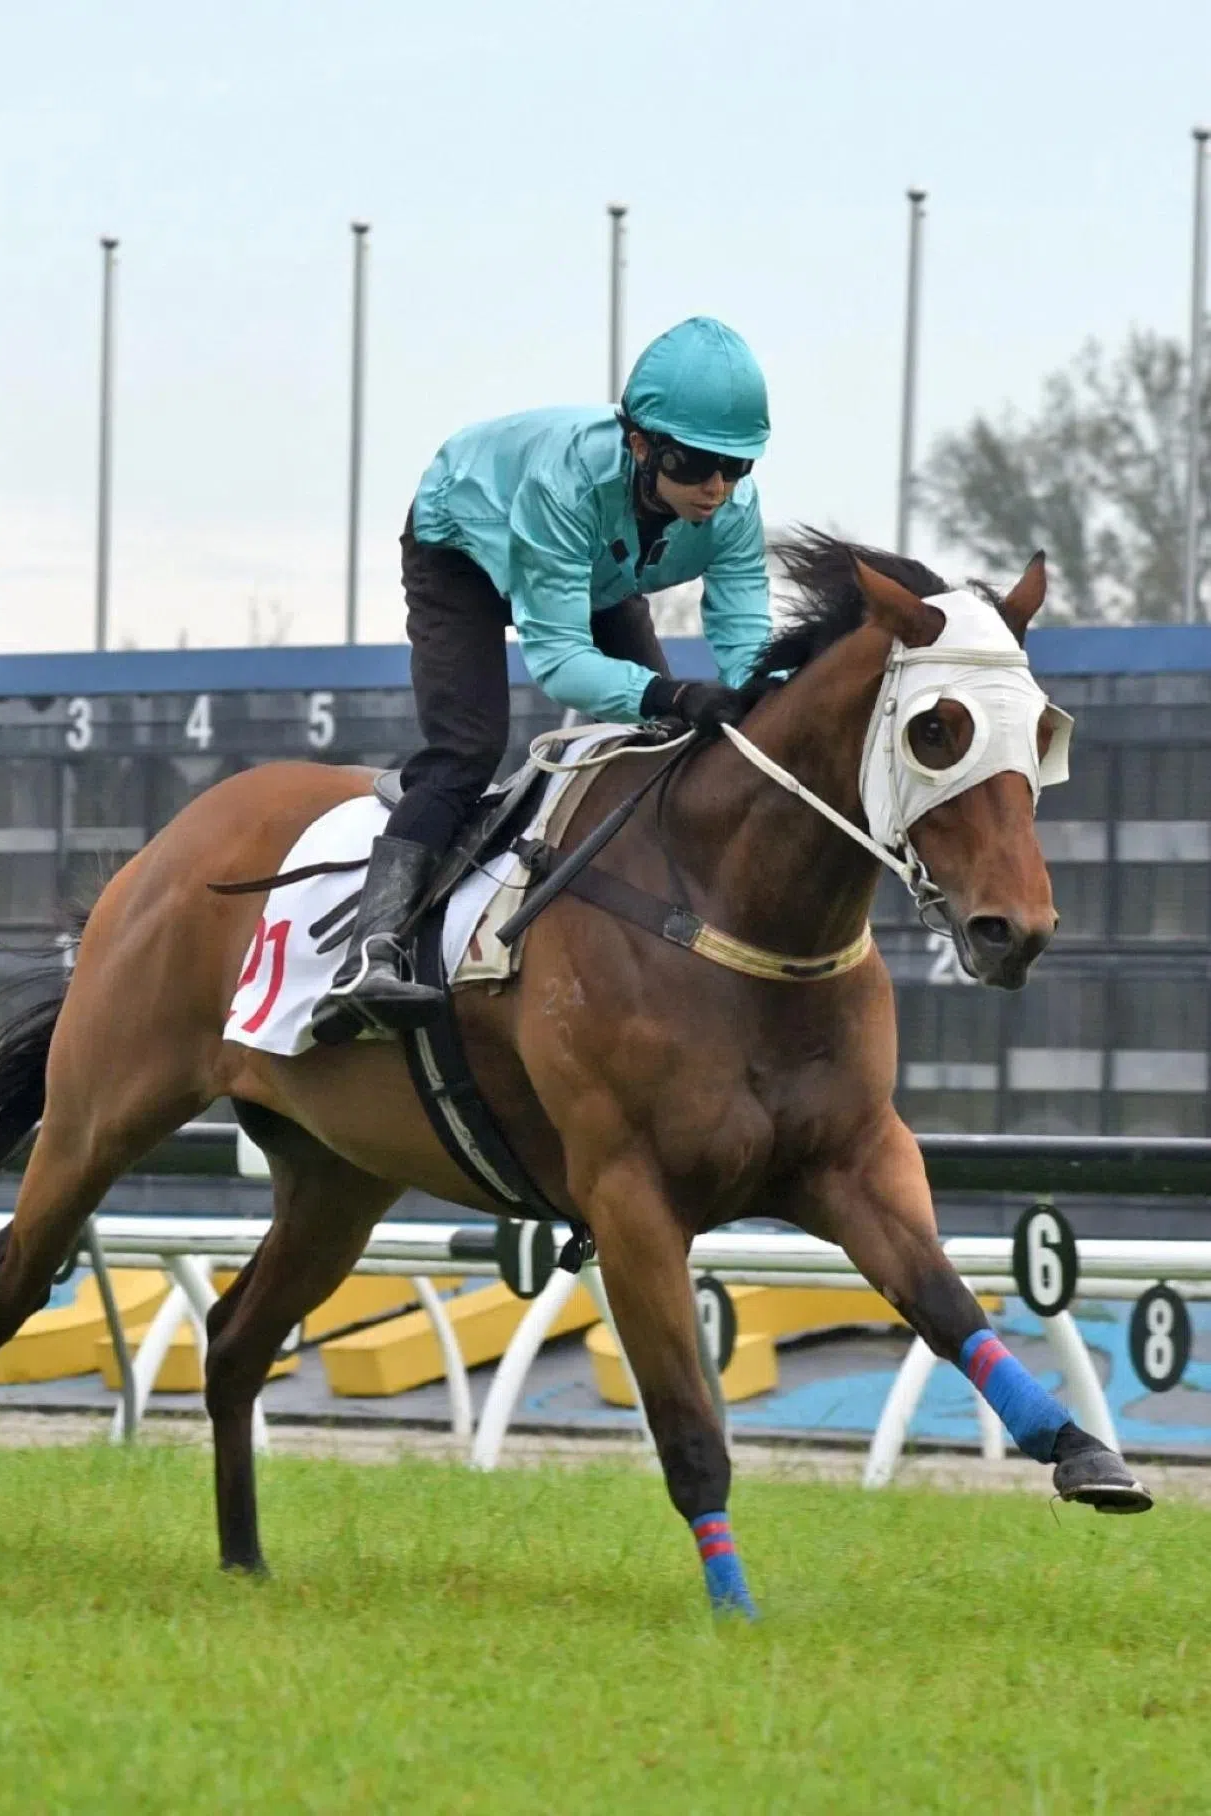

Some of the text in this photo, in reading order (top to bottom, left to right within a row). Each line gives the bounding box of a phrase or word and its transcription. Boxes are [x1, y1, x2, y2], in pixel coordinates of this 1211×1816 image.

[66, 697, 92, 752] 3
[185, 695, 213, 749] 4
[307, 692, 335, 747] 5
[1027, 1212, 1063, 1305] 6
[1144, 1299, 1174, 1380] 8
